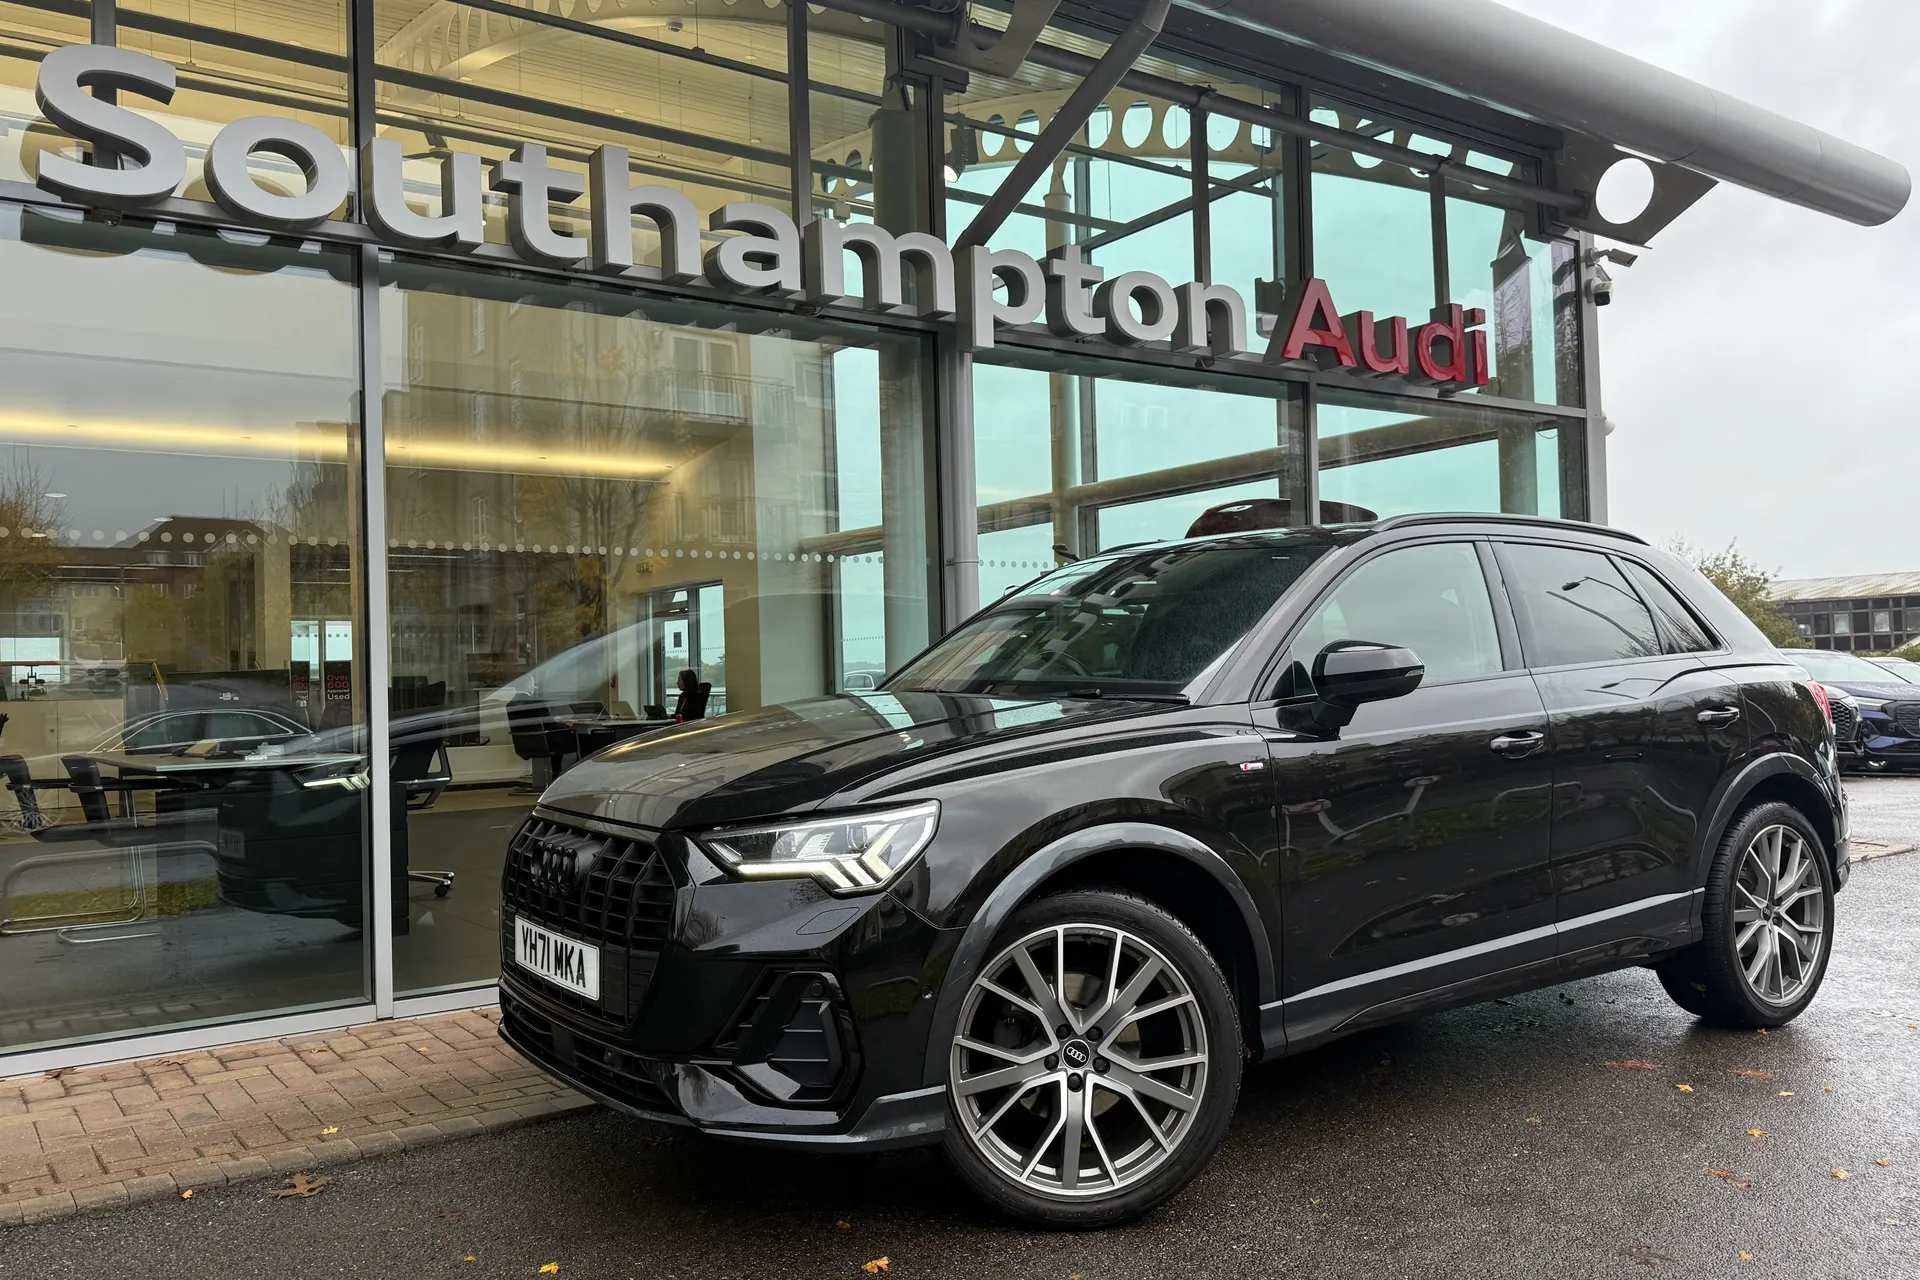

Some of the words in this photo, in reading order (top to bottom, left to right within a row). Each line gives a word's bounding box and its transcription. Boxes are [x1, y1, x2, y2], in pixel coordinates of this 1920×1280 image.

[35, 43, 1248, 353] Southampton
[1276, 277, 1490, 386] Audi
[327, 681, 349, 689] 600
[521, 924, 550, 973] YH71
[554, 938, 587, 989] MKA
